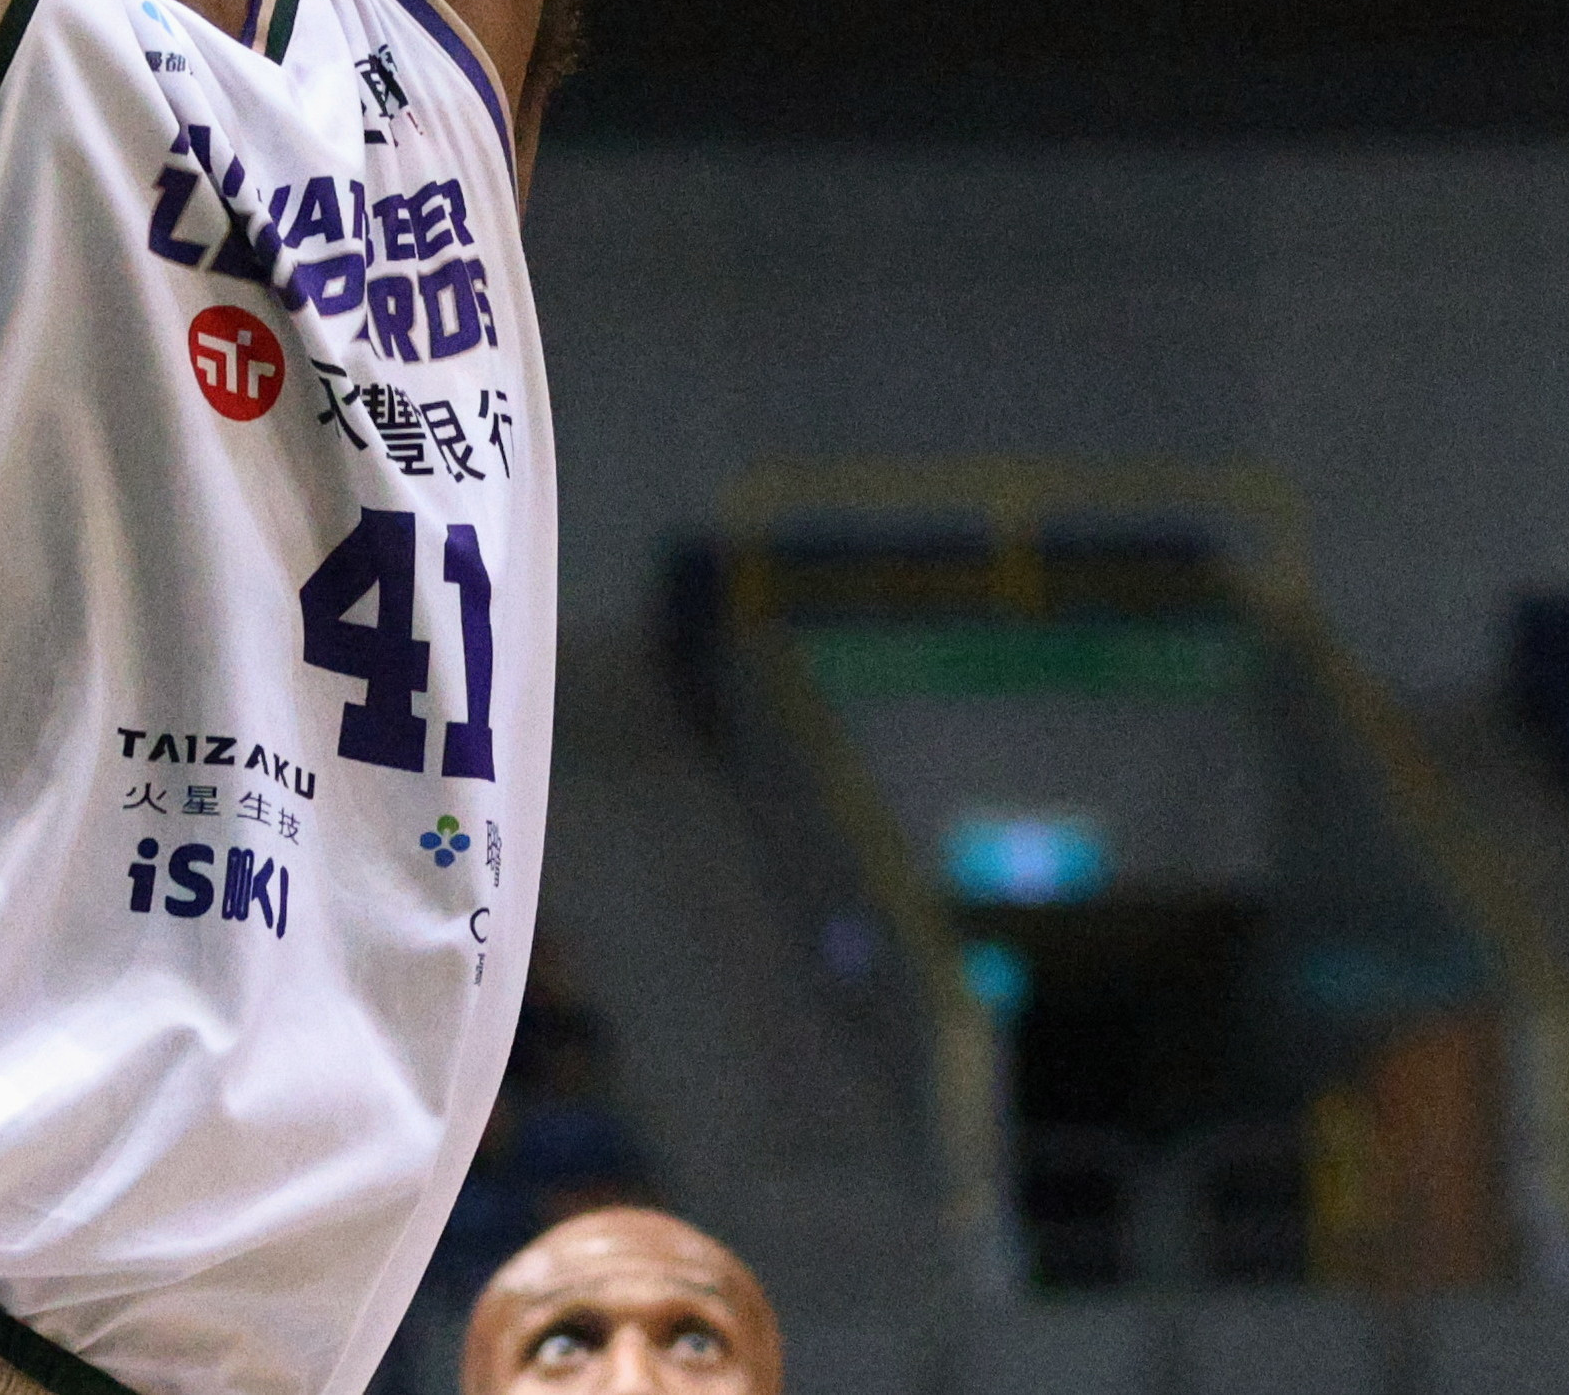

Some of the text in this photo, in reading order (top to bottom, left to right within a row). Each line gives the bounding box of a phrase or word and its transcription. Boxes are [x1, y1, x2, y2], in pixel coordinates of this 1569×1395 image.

[299, 506, 496, 783] 41
[117, 727, 316, 801] TAIZAKU
[122, 782, 301, 846] 火星生技
